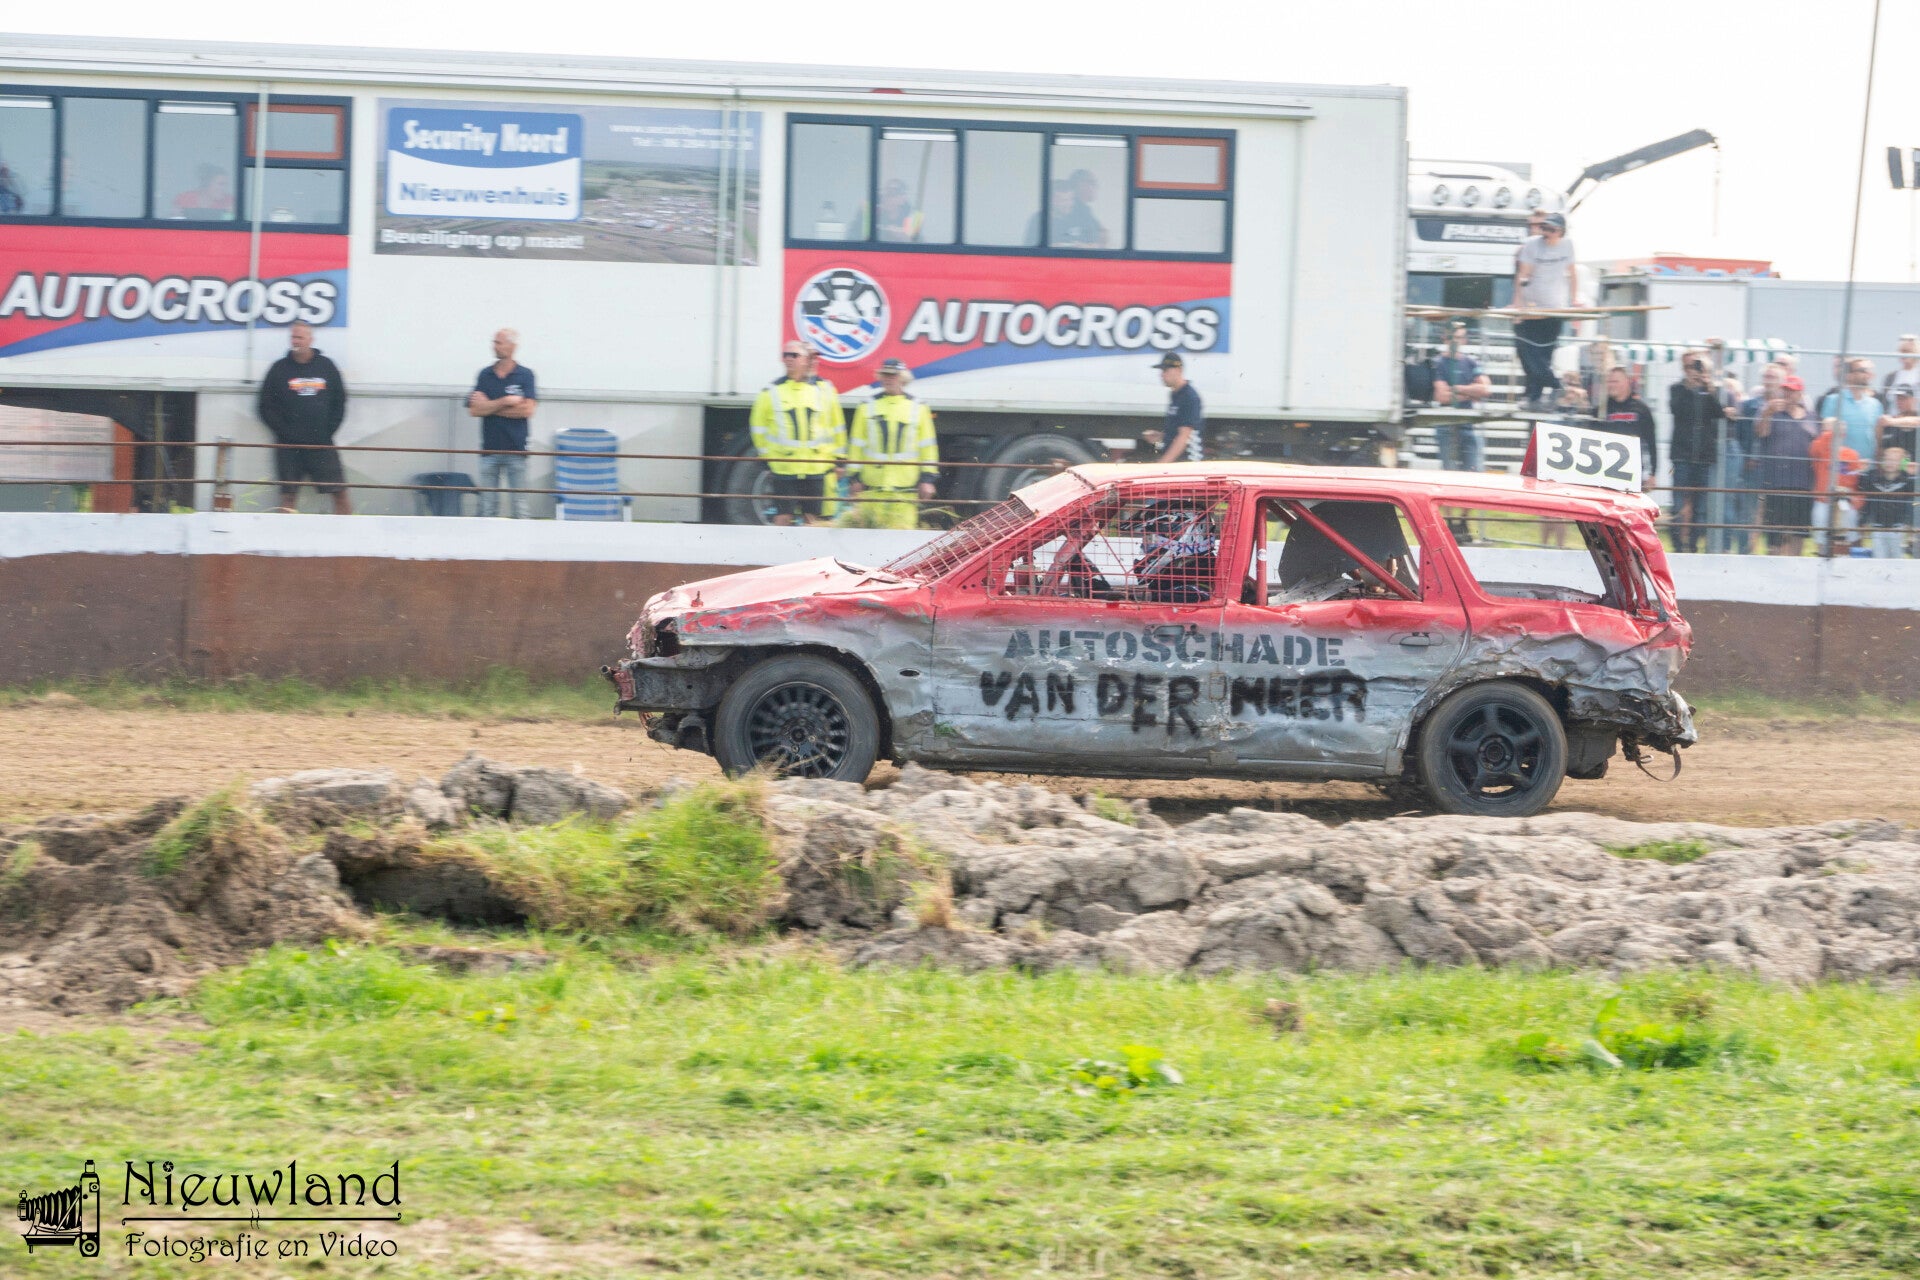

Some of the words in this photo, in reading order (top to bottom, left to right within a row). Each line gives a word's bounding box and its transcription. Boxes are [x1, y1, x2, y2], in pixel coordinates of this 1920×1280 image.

[403, 119, 498, 156] Security
[499, 123, 569, 155] Noord
[400, 182, 569, 206] Nieuwenhuis
[380, 229, 492, 250] Beveiliging
[494, 235, 523, 251] op
[0, 274, 337, 325] AUTOCROSS
[901, 300, 1220, 350] AUTOCROSS
[1546, 432, 1633, 481] 352
[1004, 628, 1345, 666] AUTOSCHADE
[980, 670, 1074, 721] VAN
[1097, 672, 1199, 737] DER
[1231, 669, 1369, 722] MEER
